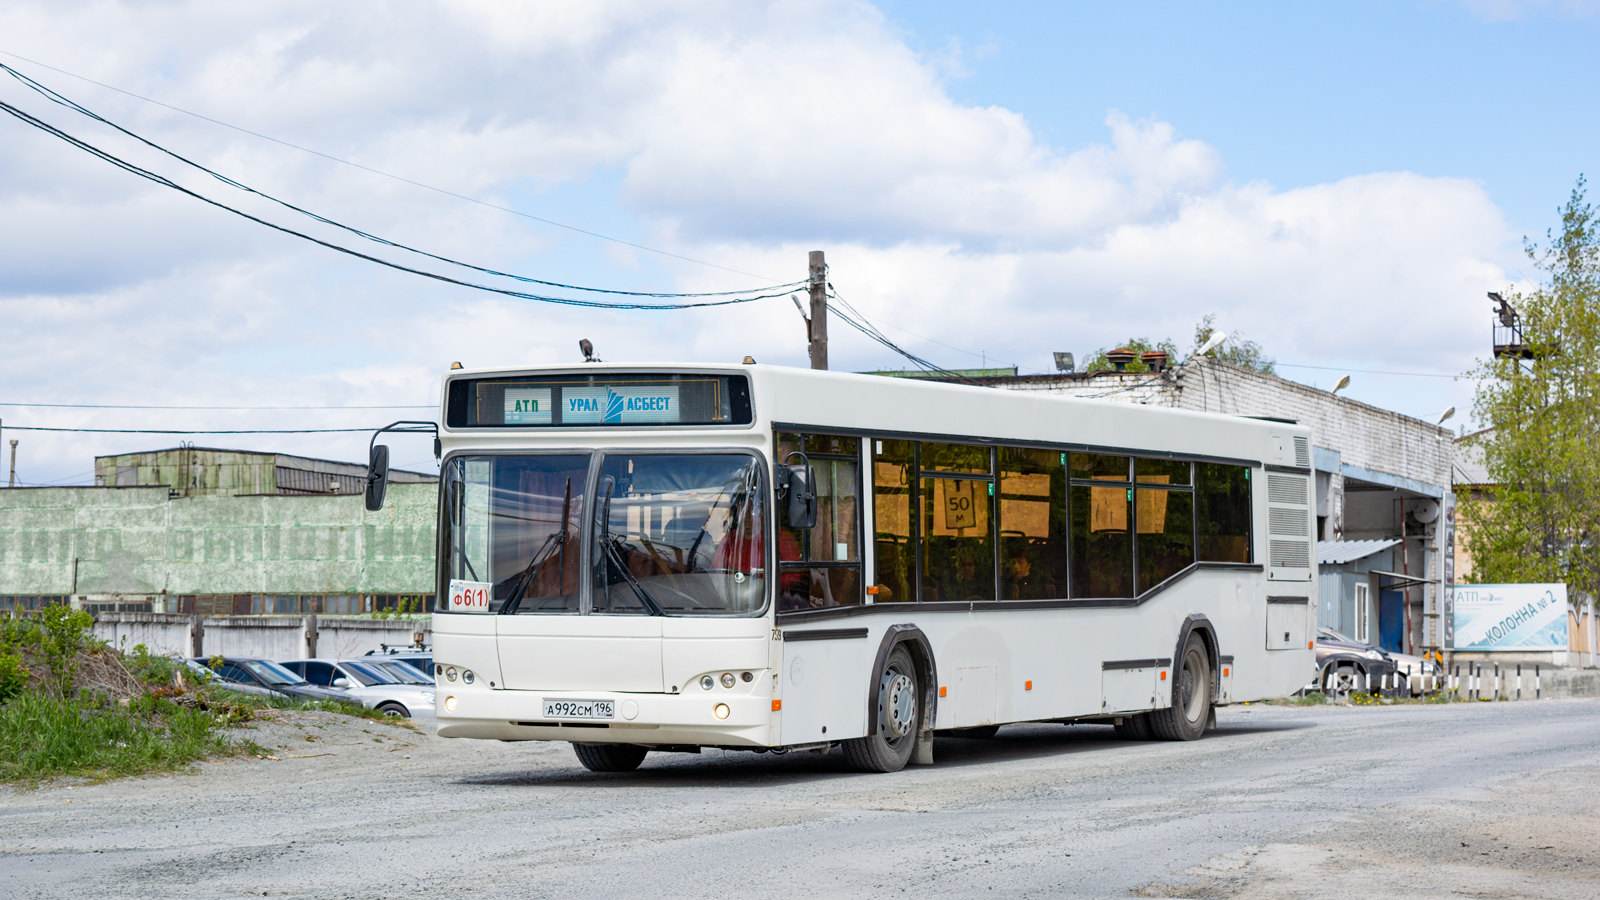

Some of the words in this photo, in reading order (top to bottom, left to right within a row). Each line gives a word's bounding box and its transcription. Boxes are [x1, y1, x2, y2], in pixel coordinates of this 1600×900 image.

[515, 400, 539, 412] АТП
[569, 398, 599, 411] УРАЛ
[627, 397, 671, 411] АСБЕСТ
[949, 496, 970, 511] 50
[1456, 591, 1479, 603] АТП
[1485, 602, 1539, 644] КОЛОННА
[1545, 589, 1557, 604] 2
[594, 702, 611, 712] 196
